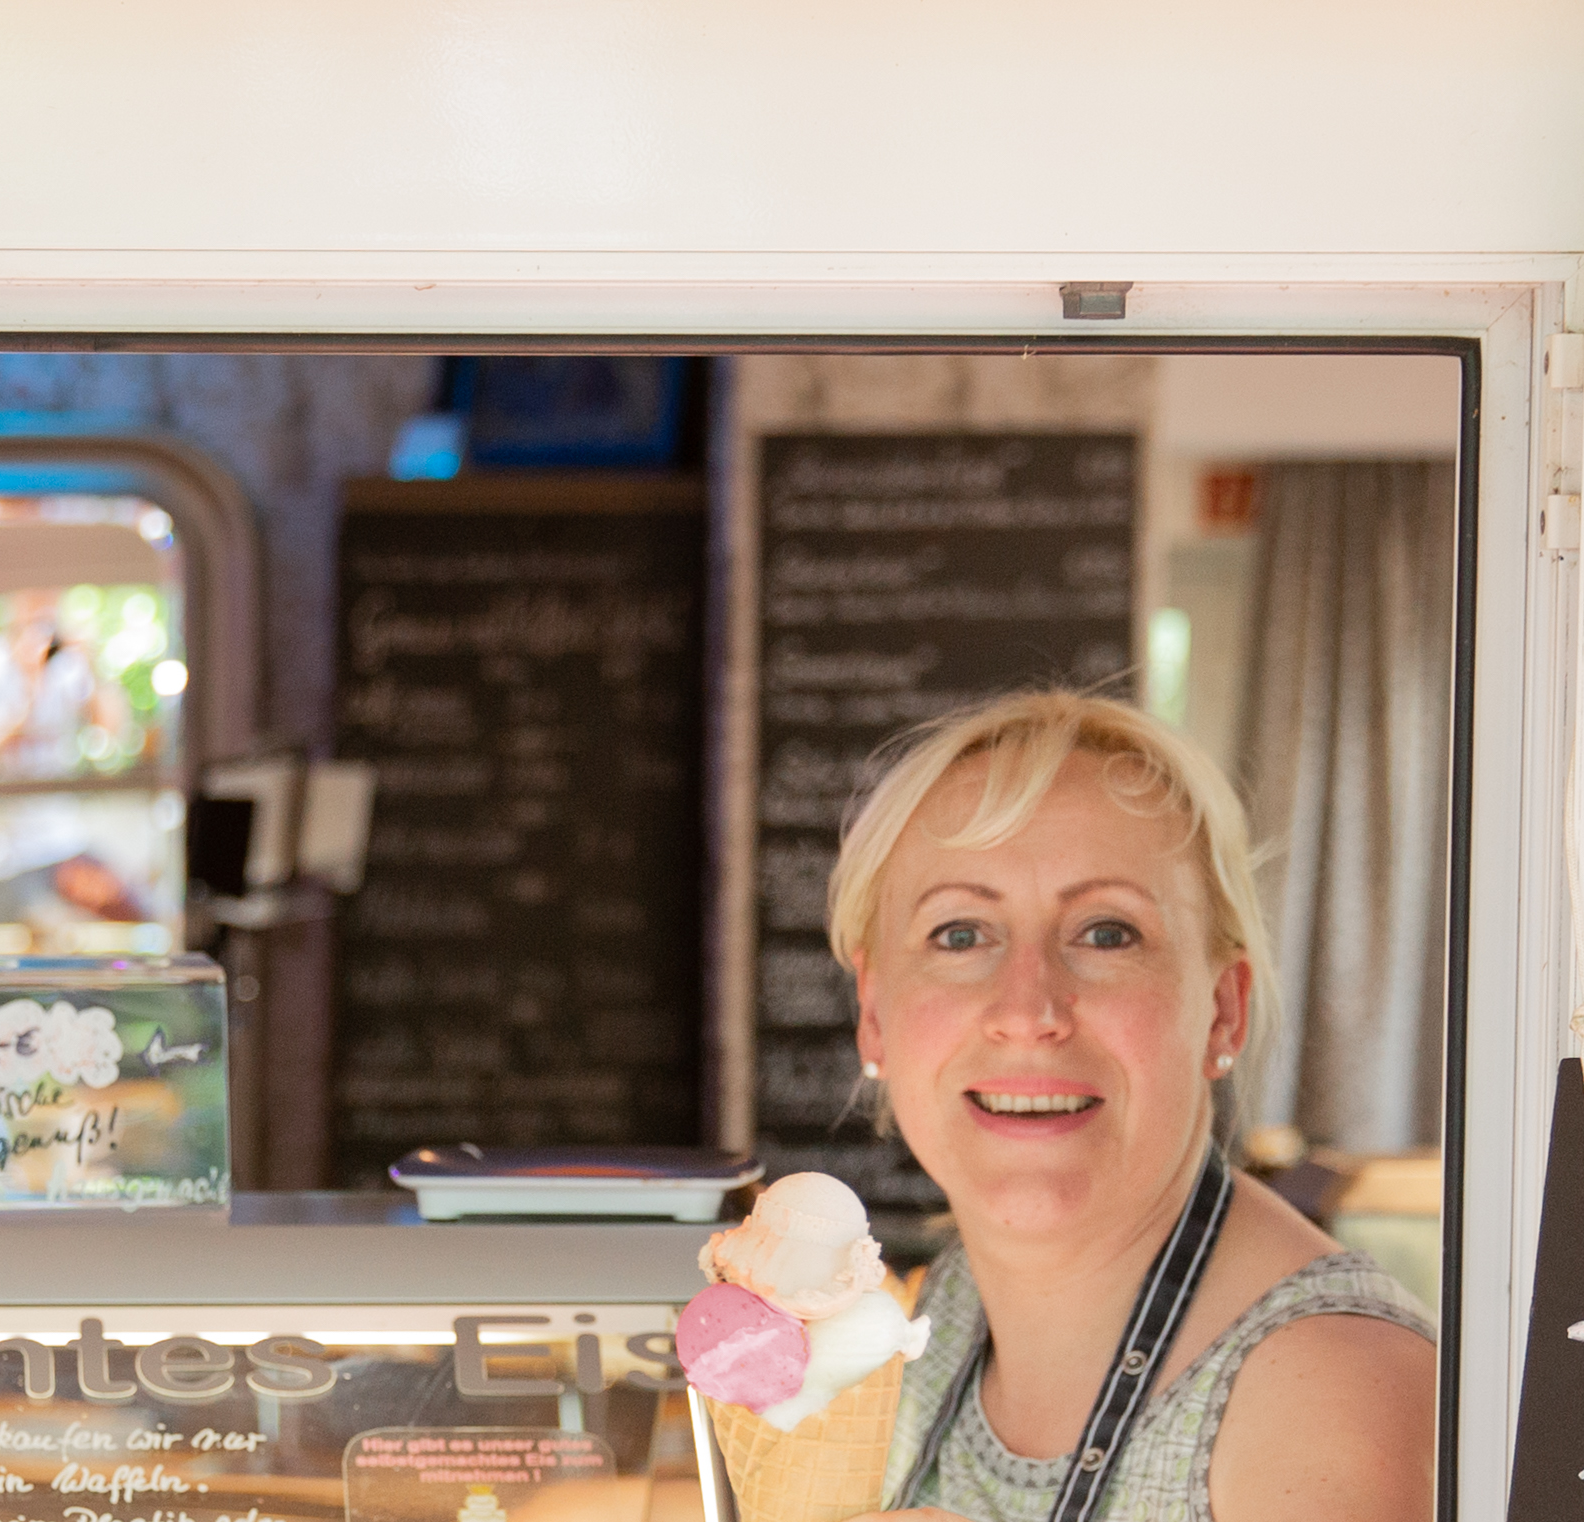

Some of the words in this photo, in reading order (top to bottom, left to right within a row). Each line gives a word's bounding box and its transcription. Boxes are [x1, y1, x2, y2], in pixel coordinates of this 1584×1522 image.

[451, 1312, 681, 1397] Eis
[126, 1423, 184, 1451] wir
[190, 1428, 266, 1453] nur
